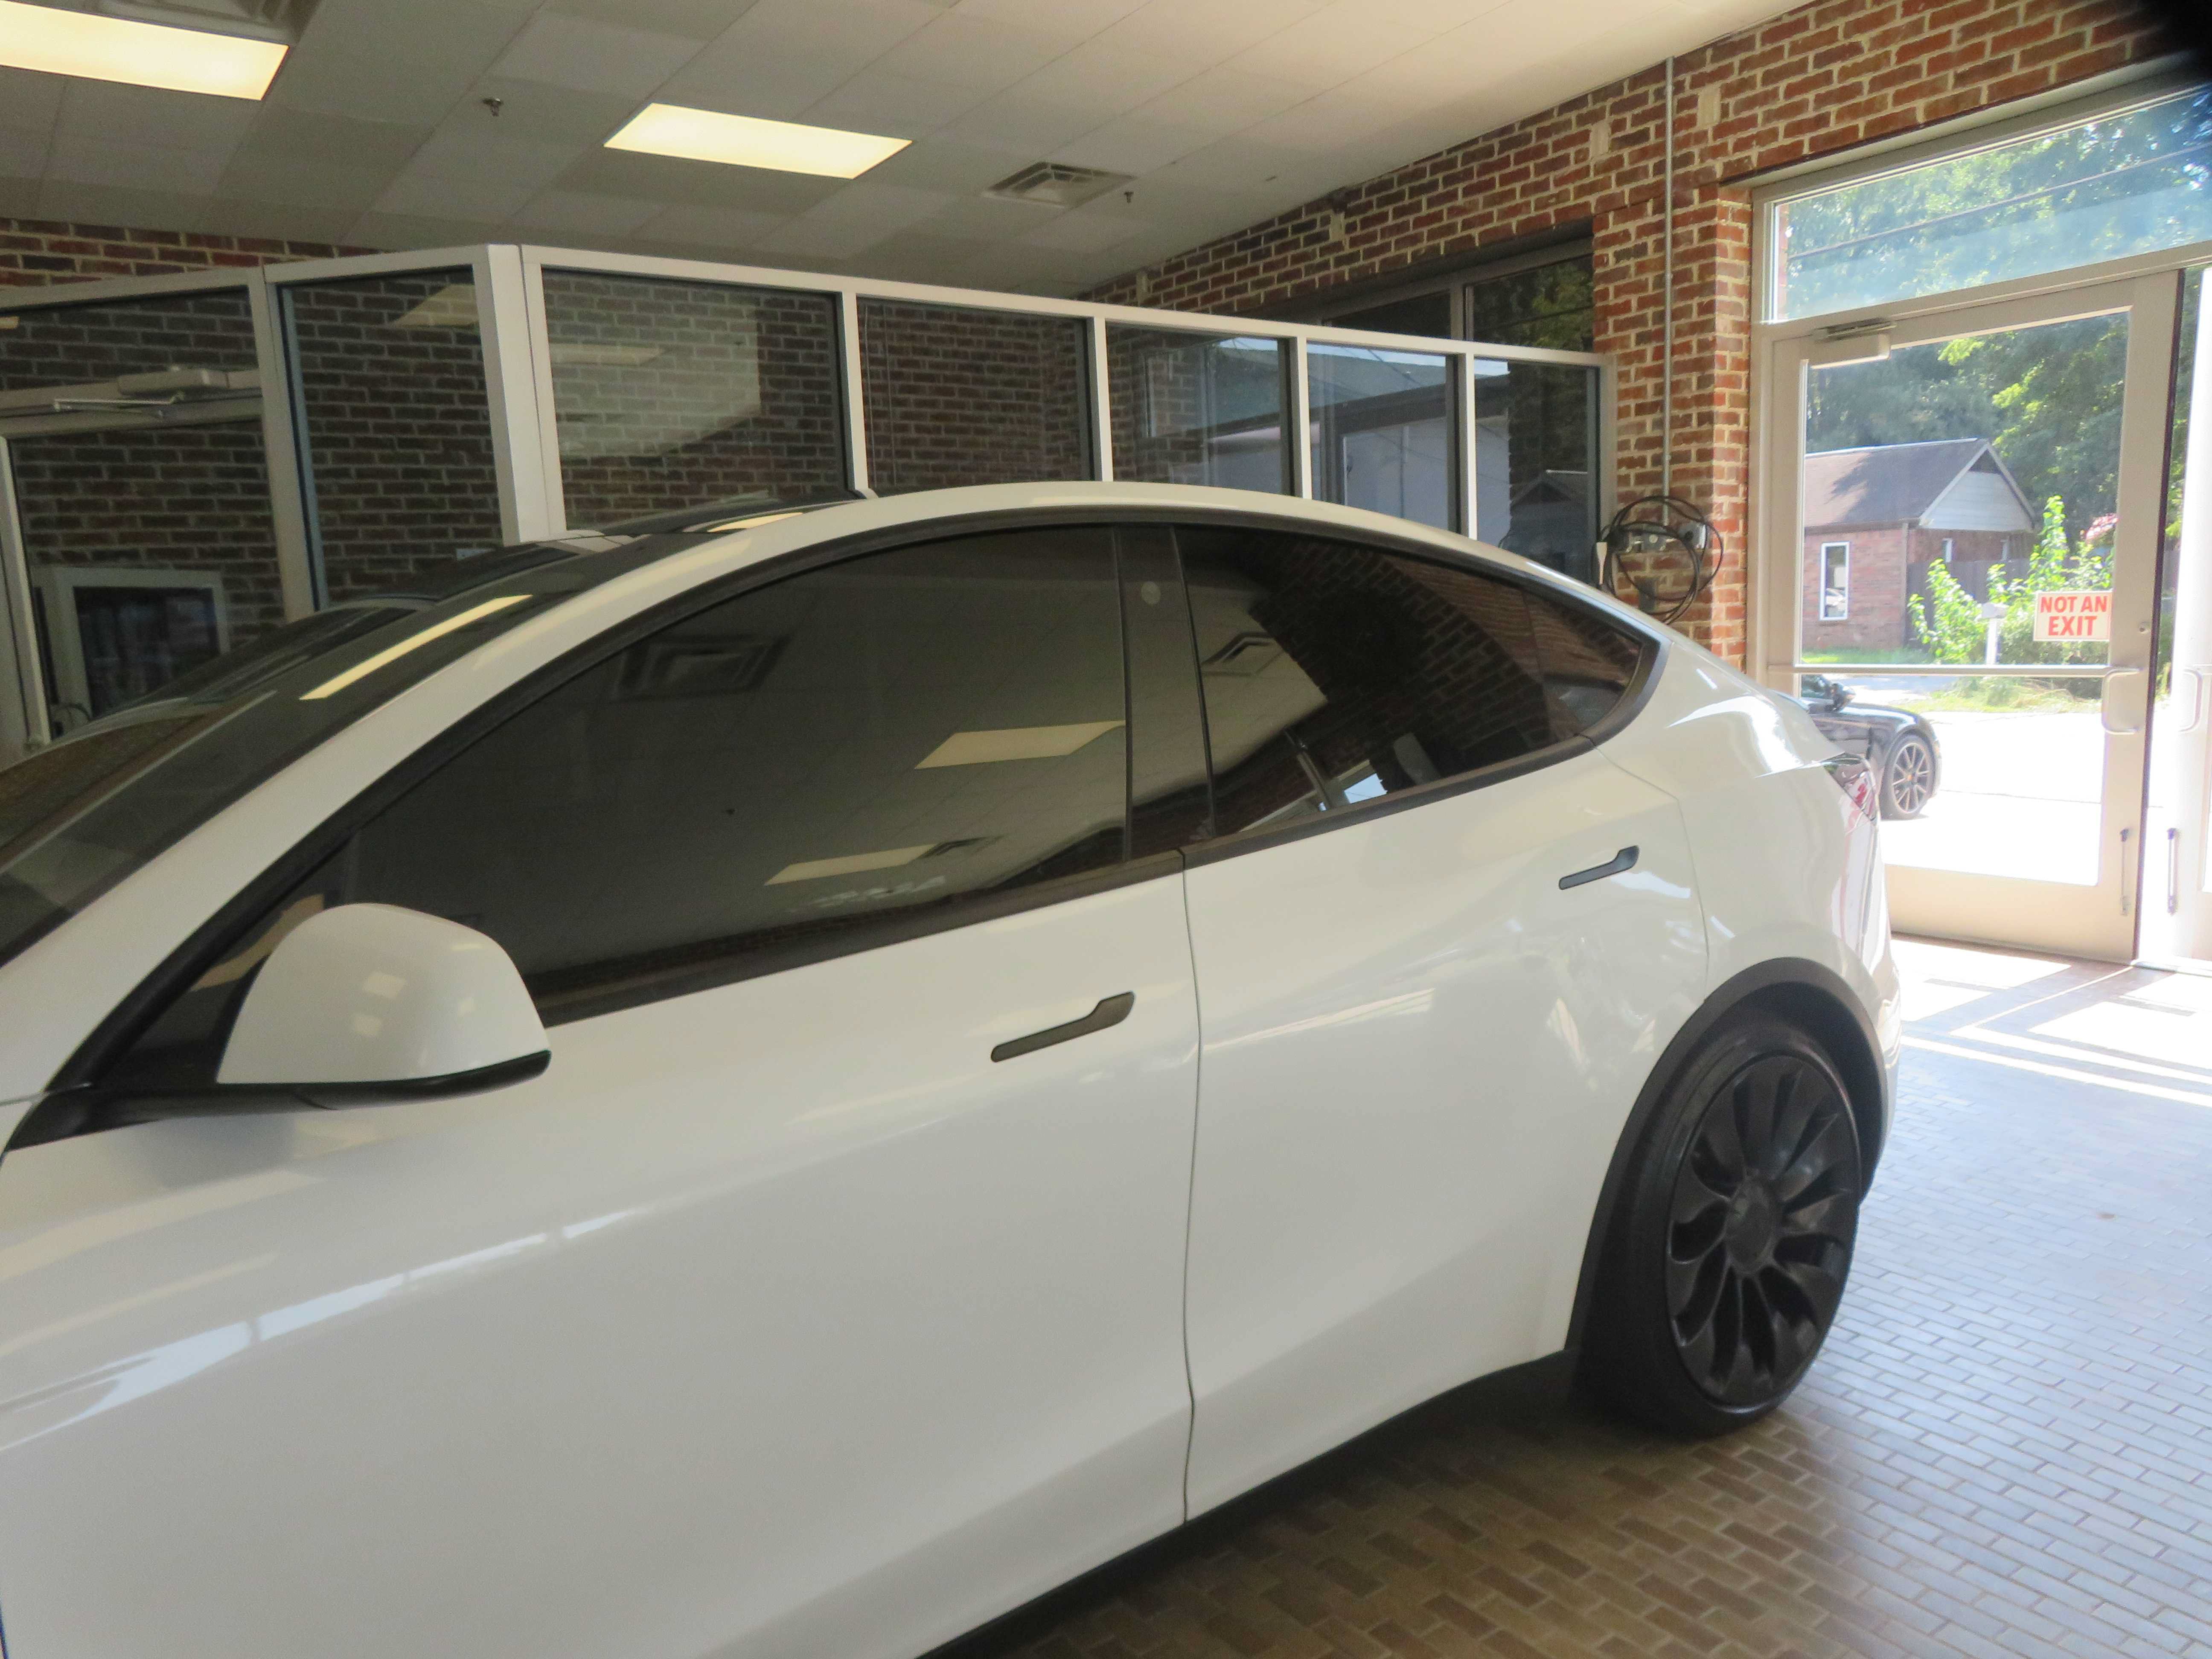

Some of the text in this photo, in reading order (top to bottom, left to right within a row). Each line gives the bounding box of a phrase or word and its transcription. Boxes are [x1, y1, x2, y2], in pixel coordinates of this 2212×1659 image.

[2041, 596, 2107, 613] NOT AN
[2048, 616, 2097, 636] EXIT
